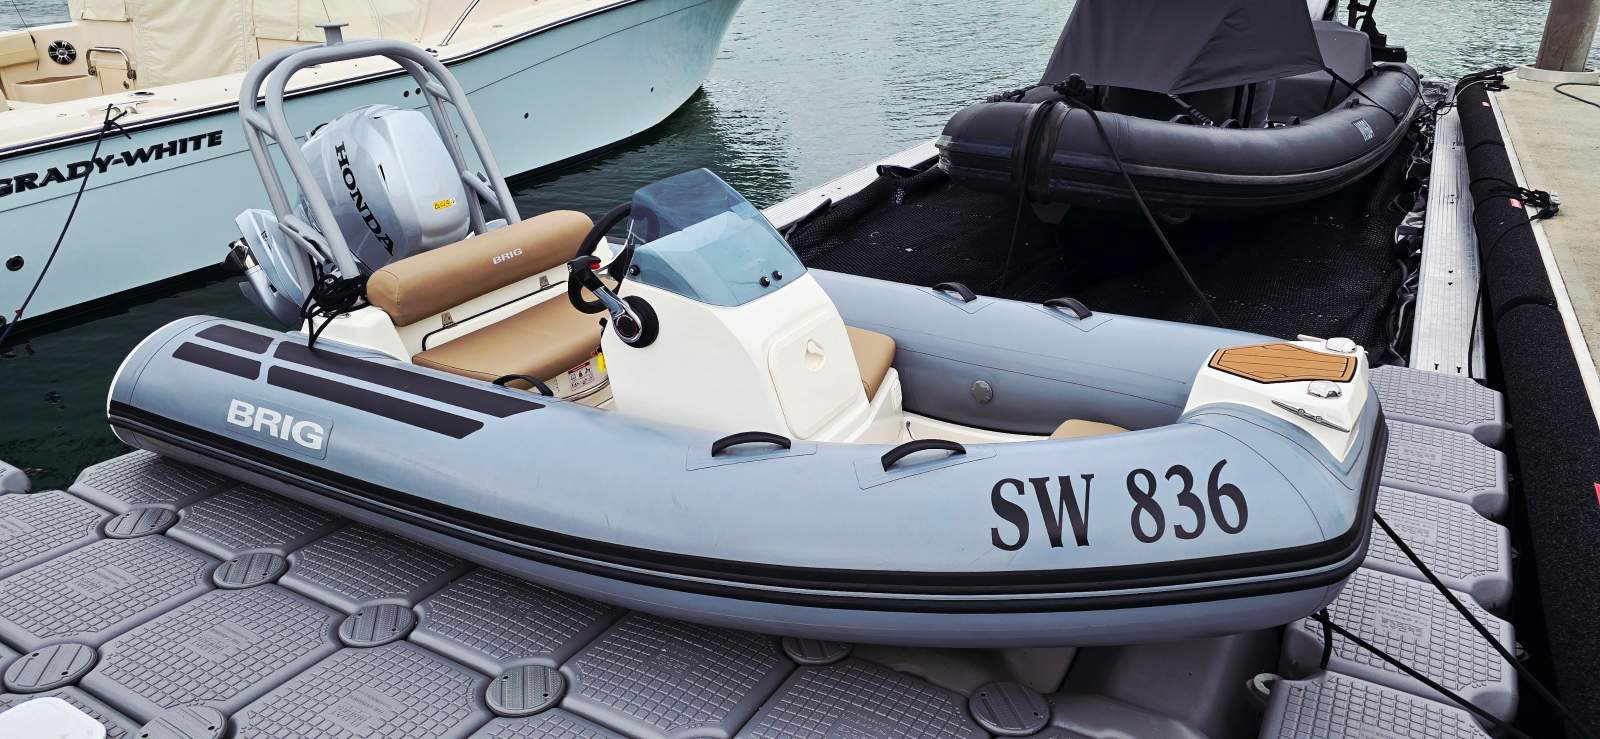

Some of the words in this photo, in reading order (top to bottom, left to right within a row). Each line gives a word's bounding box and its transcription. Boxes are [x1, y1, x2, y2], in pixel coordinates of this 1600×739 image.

[335, 141, 394, 256] HONDA
[492, 248, 523, 265] BRIG
[227, 399, 324, 450] BRIG
[991, 473, 1095, 551] SW
[1126, 459, 1249, 543] 836
